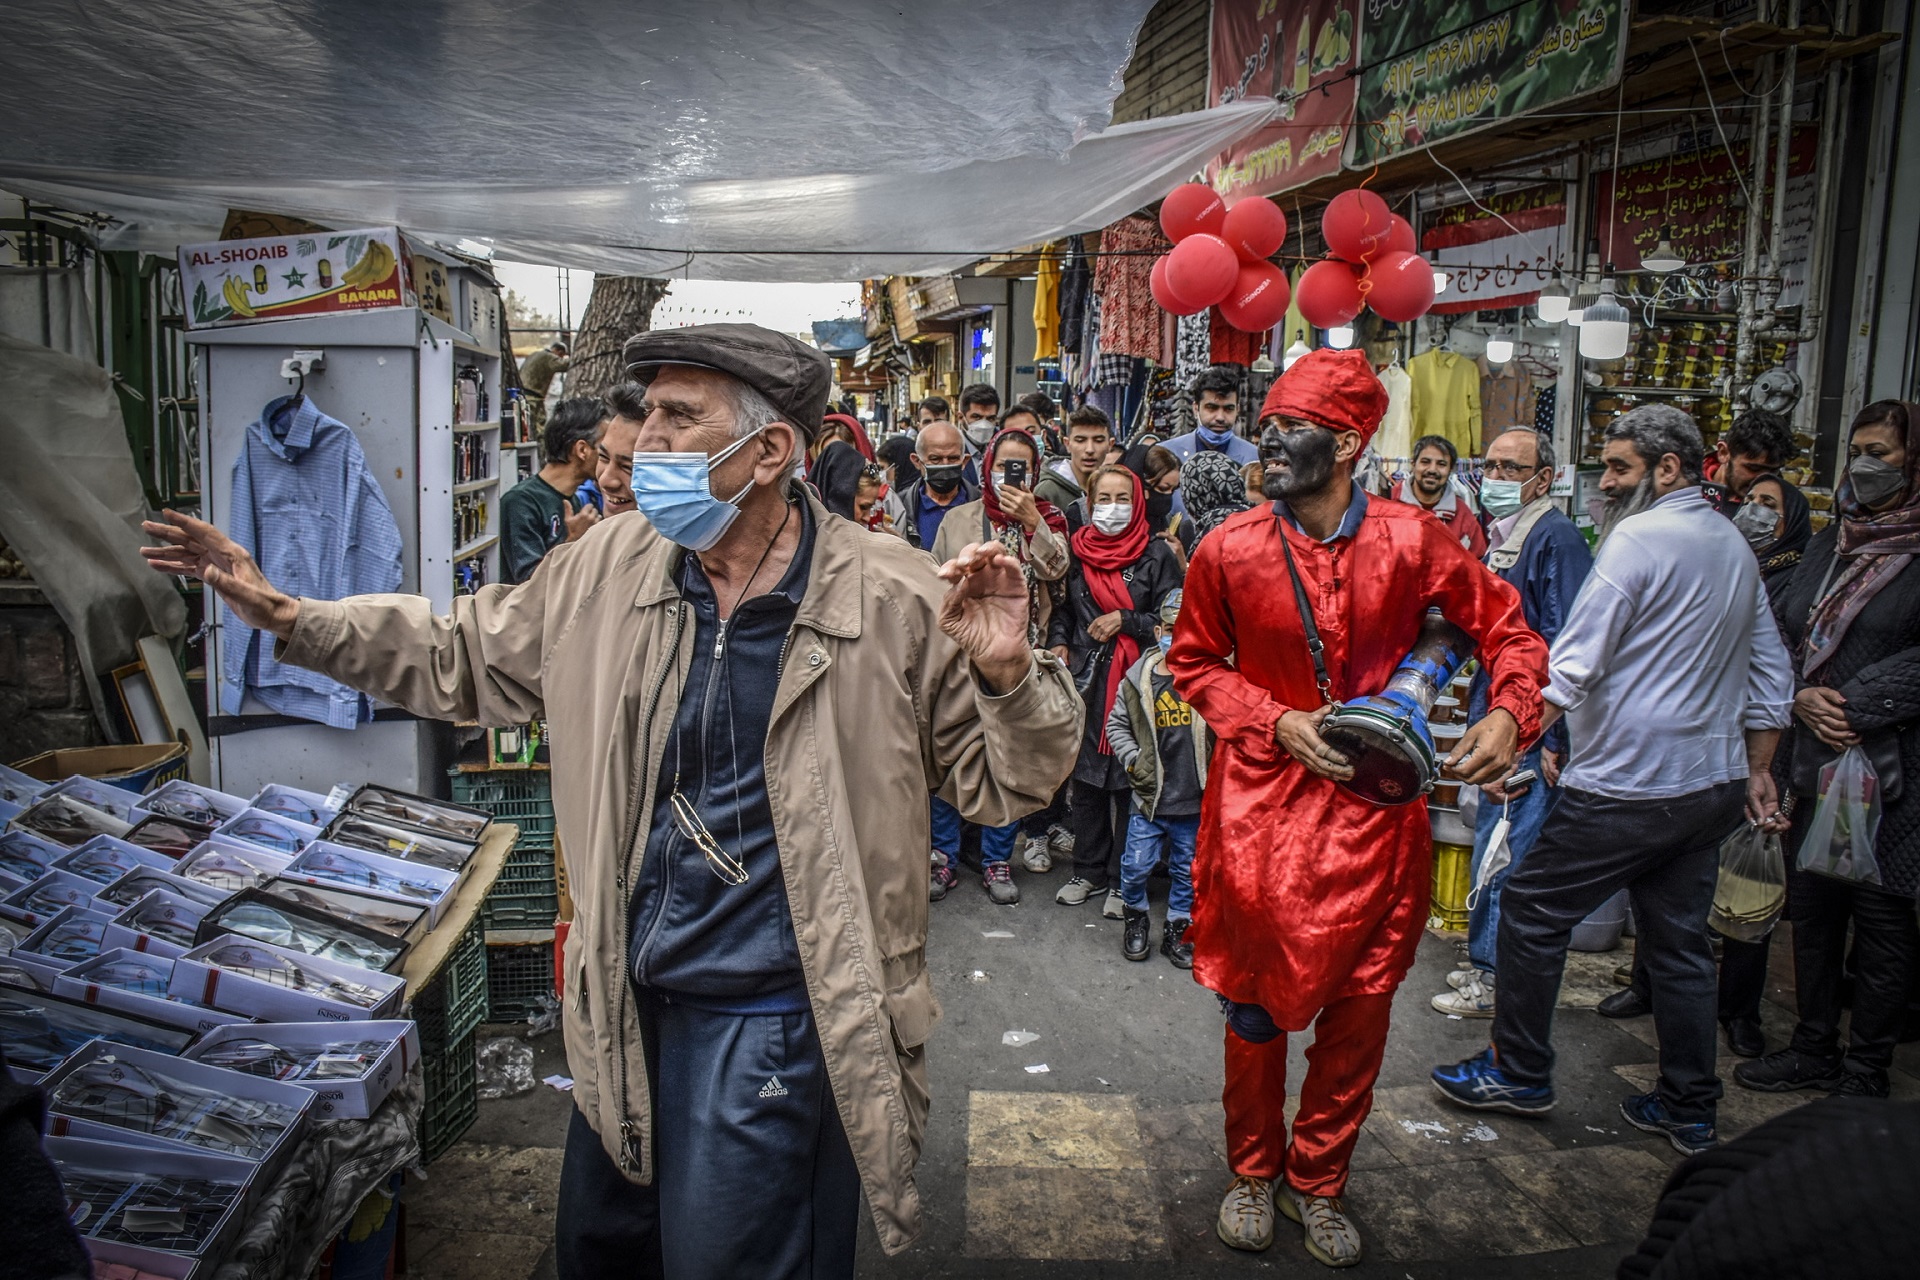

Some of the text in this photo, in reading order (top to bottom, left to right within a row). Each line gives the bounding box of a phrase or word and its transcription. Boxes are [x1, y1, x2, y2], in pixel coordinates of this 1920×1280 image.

[1525, 9, 1606, 67] شماره تماس
[192, 245, 288, 266] AL-SHOAIB
[1457, 261, 1490, 293] حراج
[1495, 254, 1529, 288] حراج
[338, 289, 397, 304] BANANA
[1157, 710, 1191, 727] dida
[758, 1088, 788, 1098] adidas
